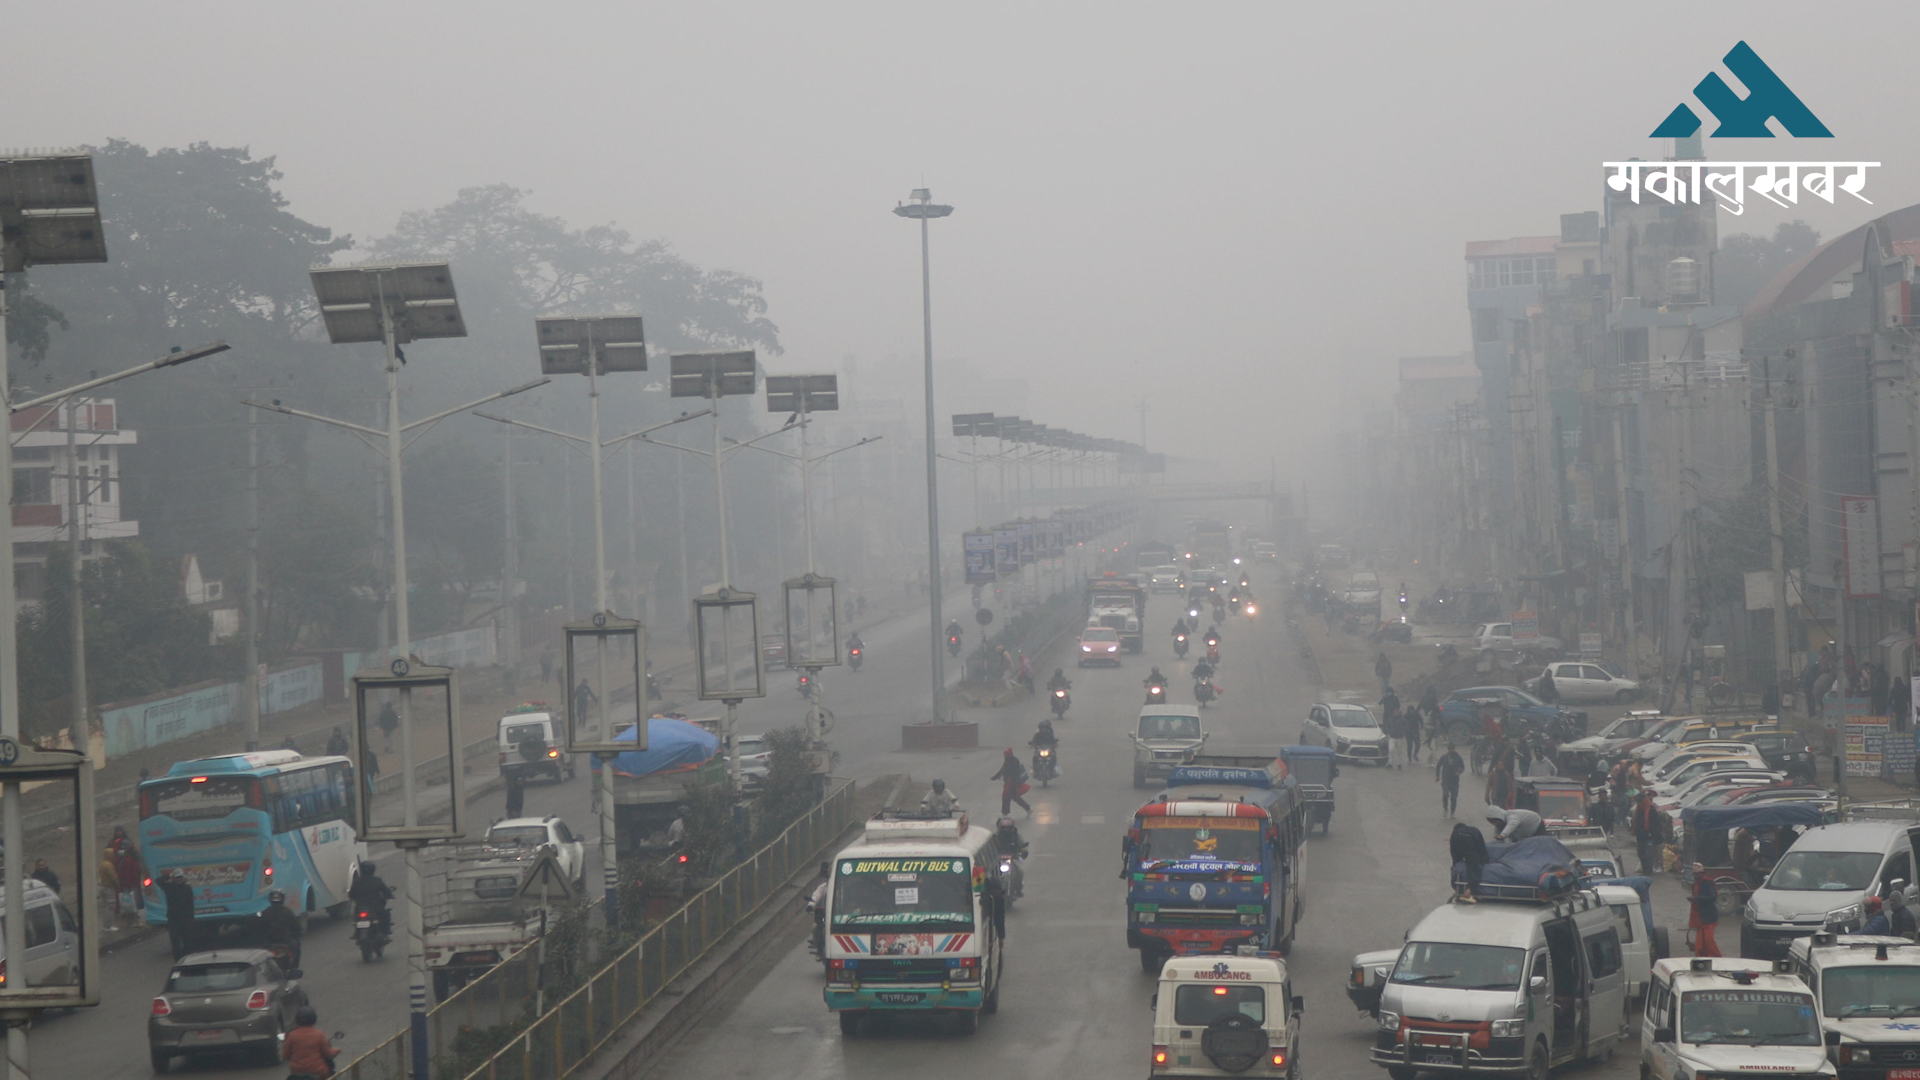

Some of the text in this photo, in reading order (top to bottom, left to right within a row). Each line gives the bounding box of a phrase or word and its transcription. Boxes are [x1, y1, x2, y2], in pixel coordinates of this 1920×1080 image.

[393, 661, 407, 674] 48
[1187, 769, 1247, 780] पशुपति दर्शन
[855, 861, 950, 873] BUTWAL CITY BUS
[1194, 971, 1252, 980] AMBULANCE
